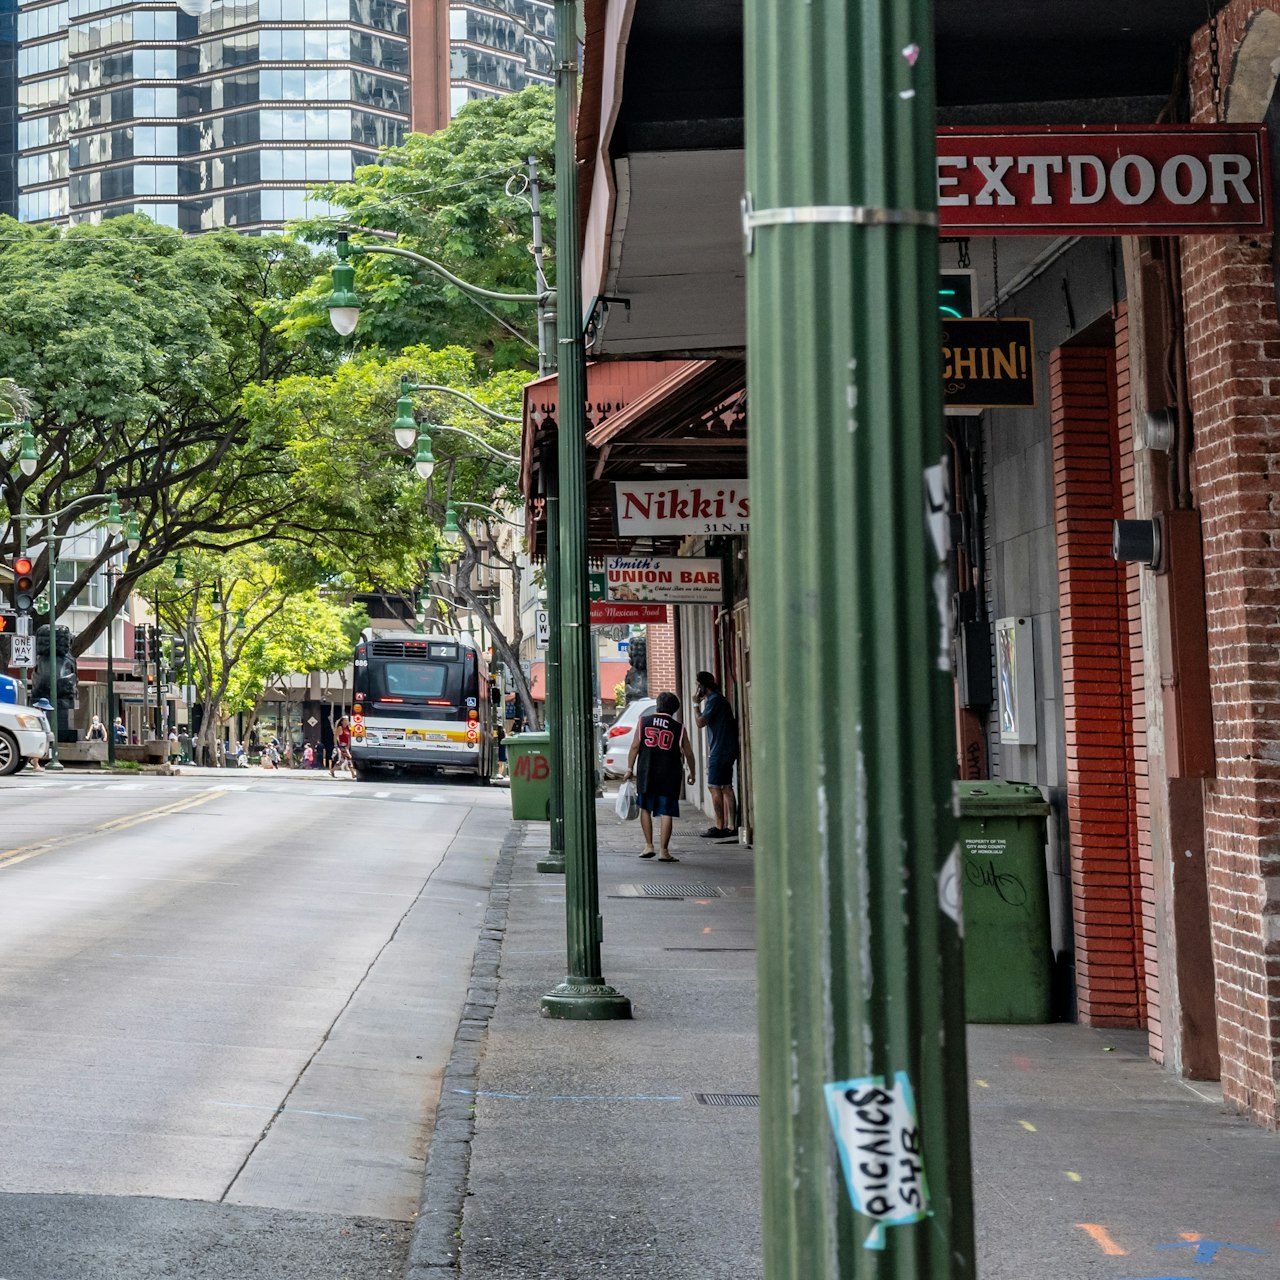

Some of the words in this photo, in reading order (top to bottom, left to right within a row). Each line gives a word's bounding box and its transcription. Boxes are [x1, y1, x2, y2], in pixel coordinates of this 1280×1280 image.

[936, 154, 1255, 206] EXTDOOR
[942, 341, 1027, 380] CHIN!
[622, 488, 750, 520] Nikki's
[704, 523, 718, 533] 31
[722, 523, 737, 532] N.
[609, 556, 661, 570] Smith's
[608, 570, 673, 584] UNION
[680, 571, 720, 584] BAR
[589, 580, 601, 592] ia
[605, 606, 639, 617] Mexican
[641, 605, 660, 617] Food
[15, 638, 31, 646] ONE
[15, 647, 31, 655] WAY
[440, 647, 447, 656] 2
[652, 717, 669, 729] HIC
[644, 726, 674, 750] 50
